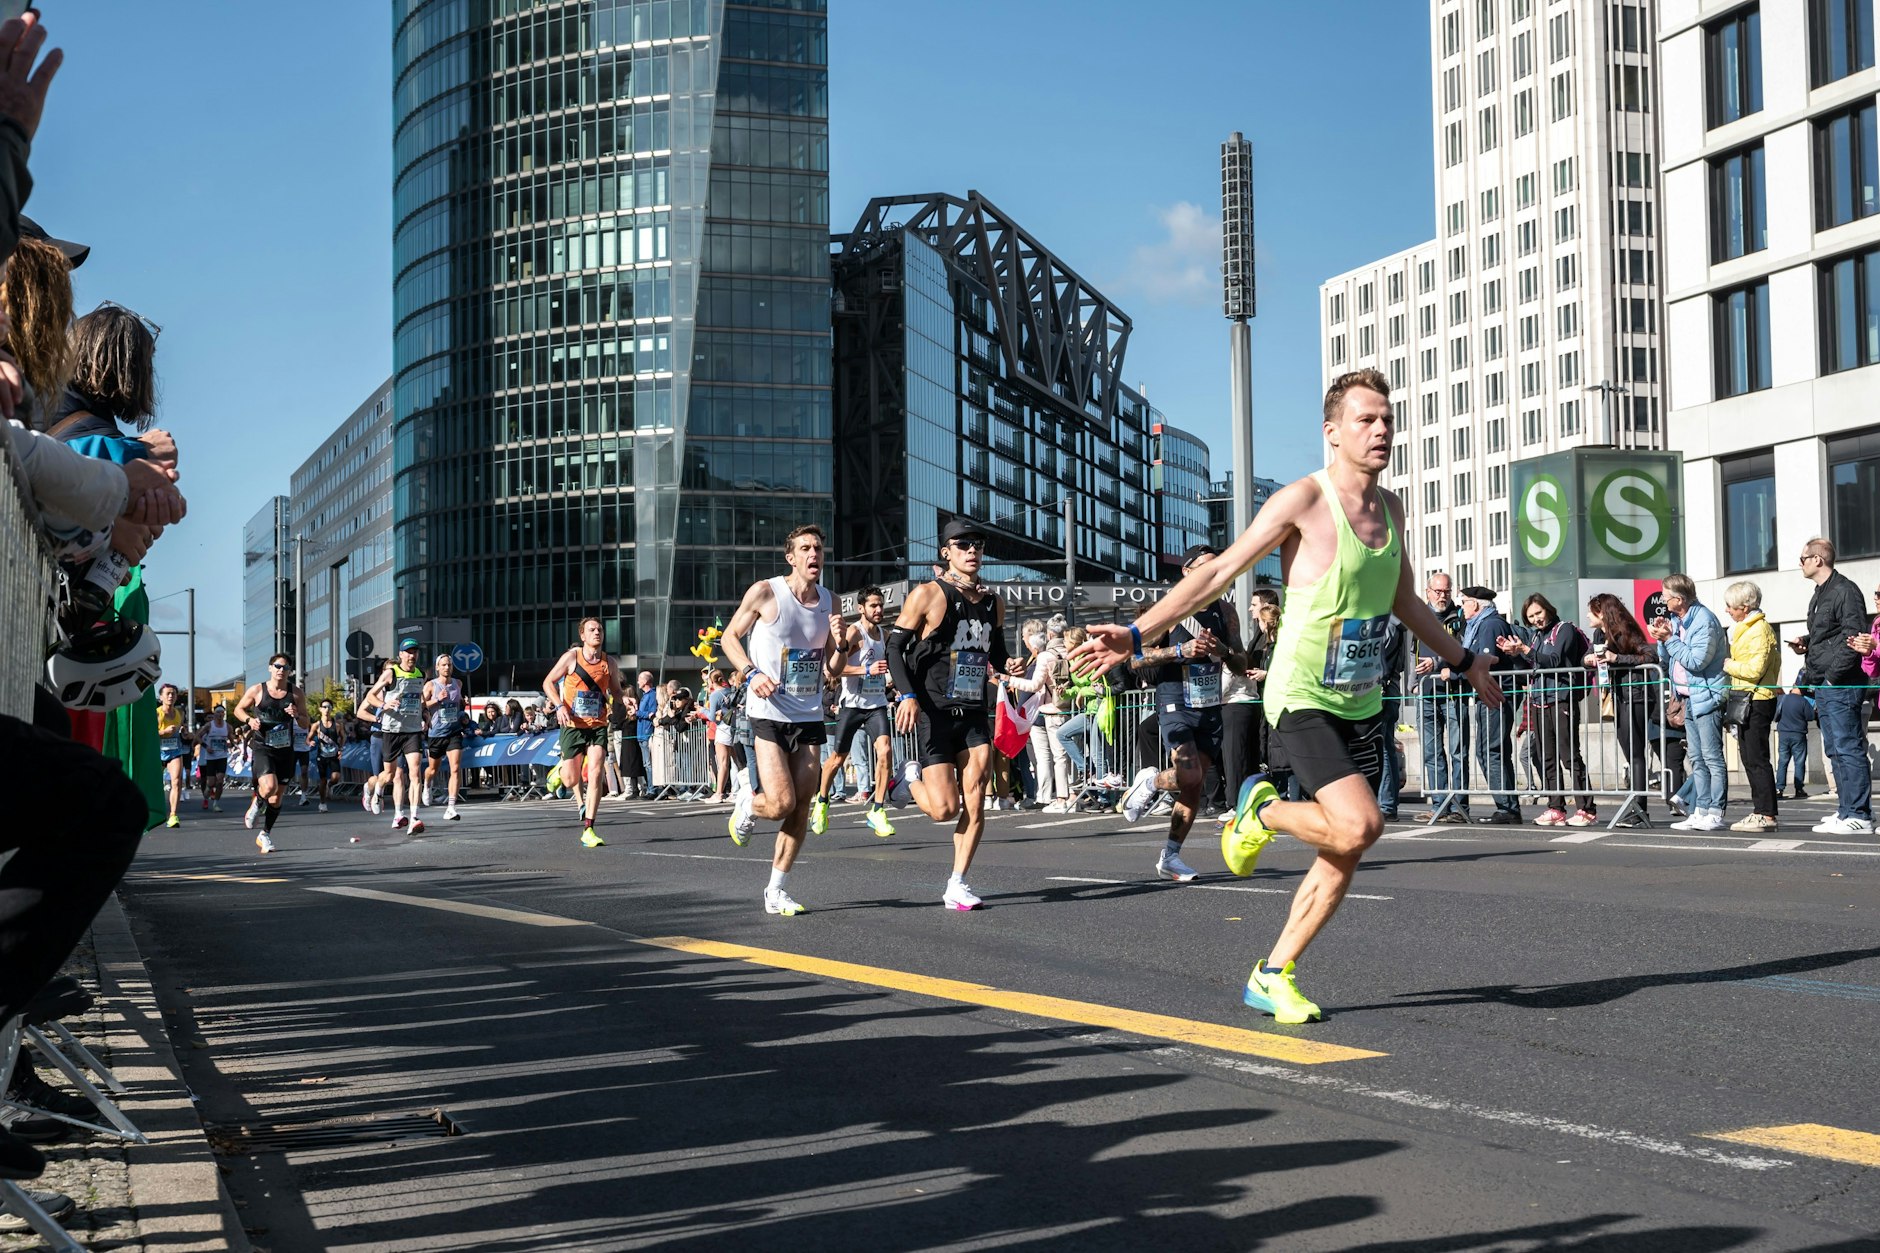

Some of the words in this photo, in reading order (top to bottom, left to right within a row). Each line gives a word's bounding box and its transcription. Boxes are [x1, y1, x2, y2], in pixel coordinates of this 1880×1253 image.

[1526, 481, 1561, 560] S
[1604, 475, 1660, 556] S
[1655, 606, 1667, 615] OF
[1346, 641, 1380, 660] 8616
[792, 662, 819, 673] 55192
[959, 666, 985, 677] 83823
[1192, 675, 1217, 687] 18855
[1335, 683, 1349, 692] YOU
[1351, 682, 1363, 692] GOT
